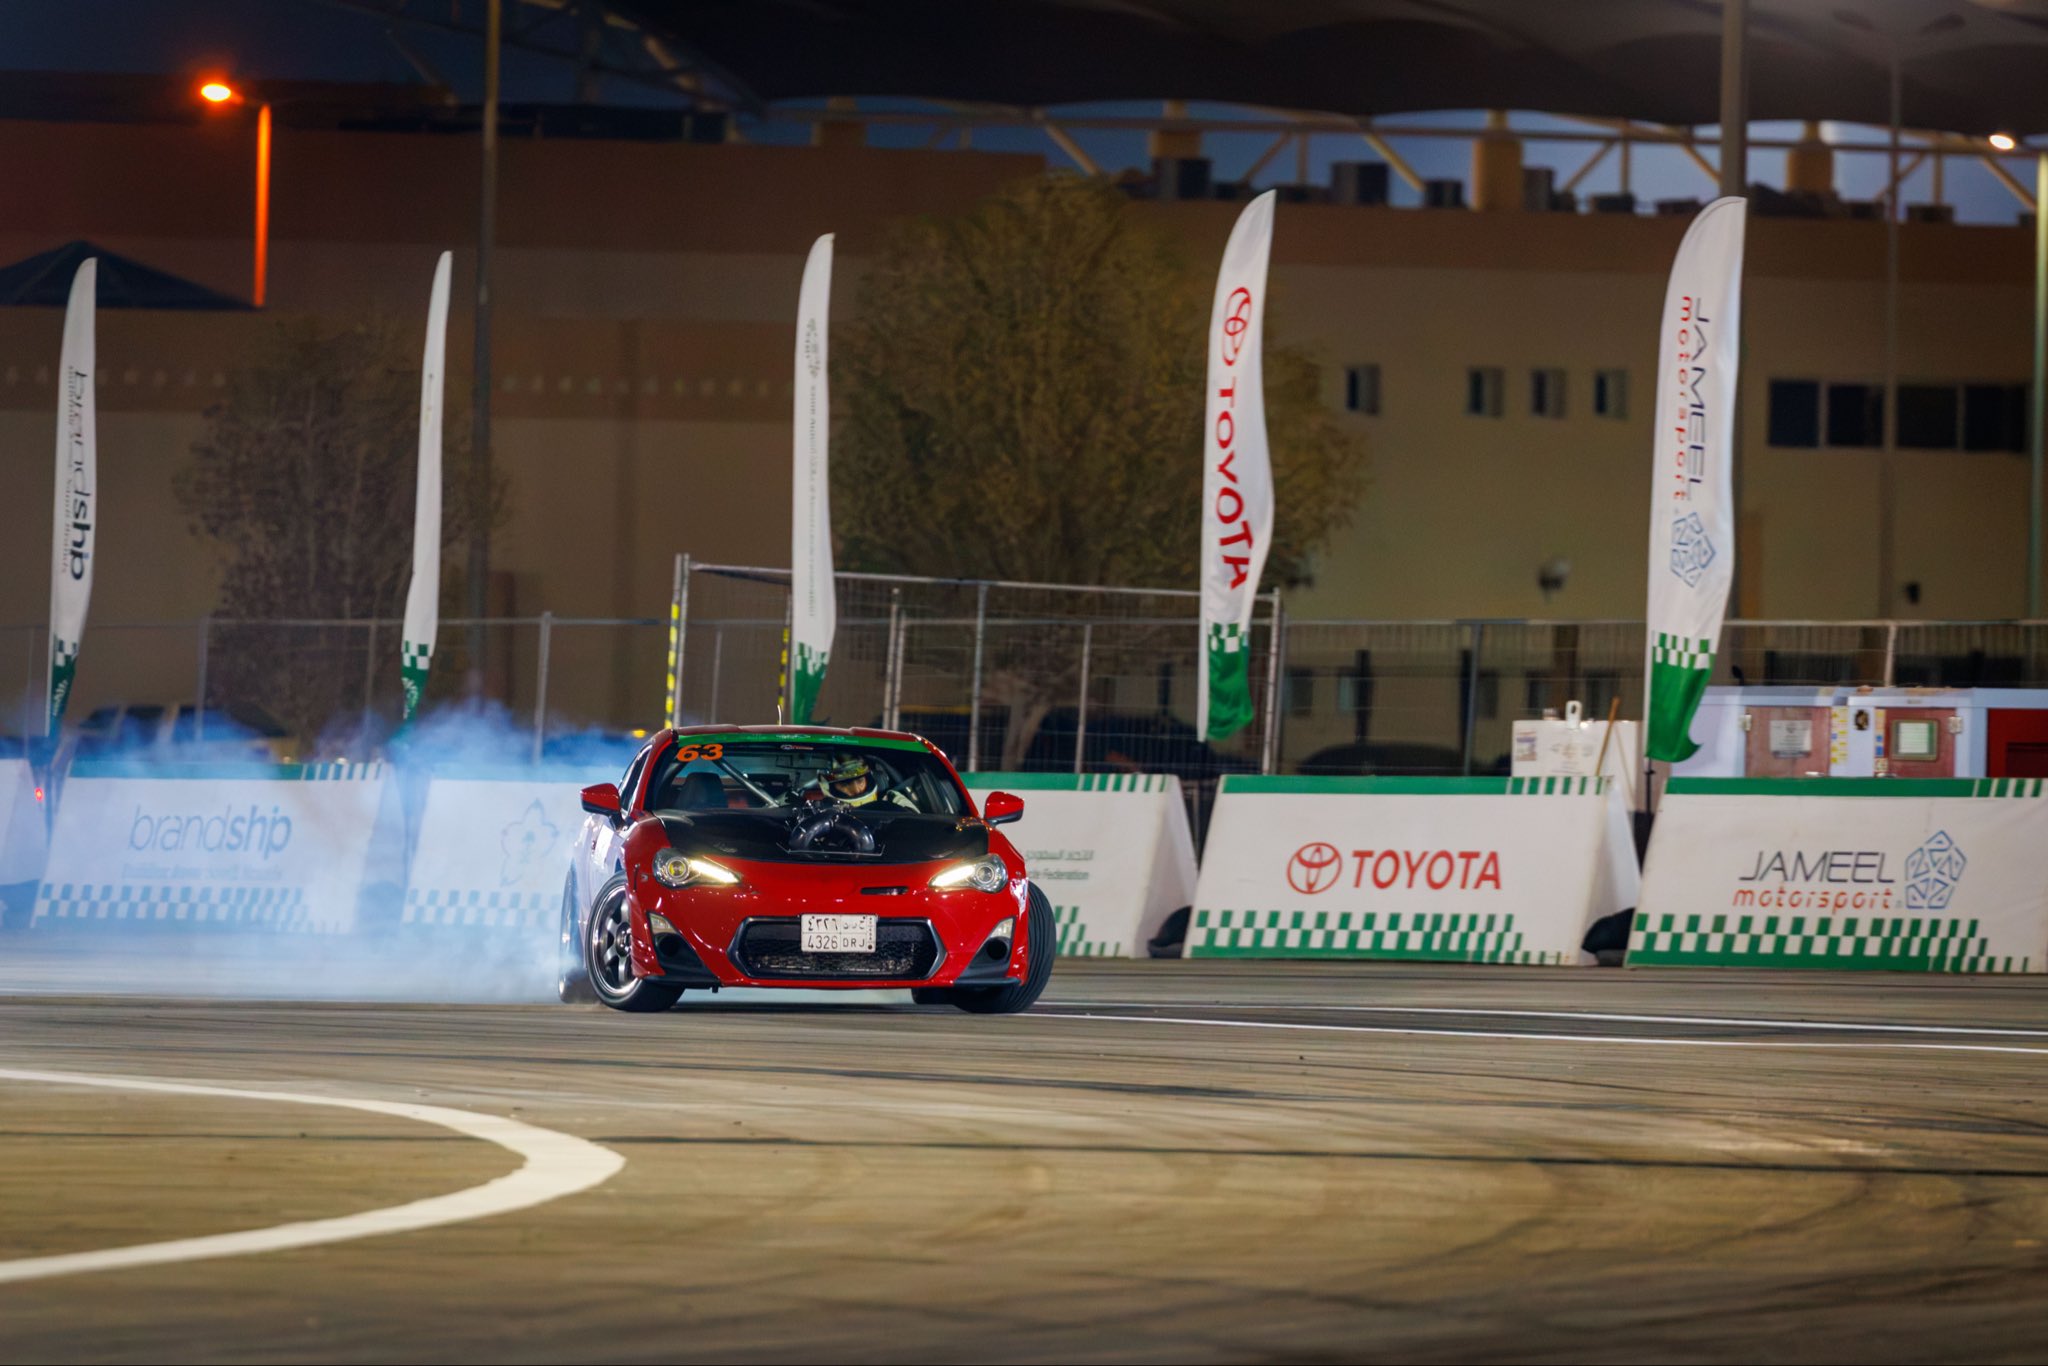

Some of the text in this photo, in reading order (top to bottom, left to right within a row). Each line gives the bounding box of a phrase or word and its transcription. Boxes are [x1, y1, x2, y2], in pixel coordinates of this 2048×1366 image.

[1673, 296, 1692, 500] motorsport
[1689, 297, 1710, 501] JAMEEL
[1216, 376, 1253, 590] TOYOTA
[676, 743, 724, 762] 63
[1352, 849, 1502, 890] TOYOTA
[1739, 850, 1895, 883] JAMEEL
[1732, 886, 1893, 915] motorsport
[808, 935, 838, 950] 4326
